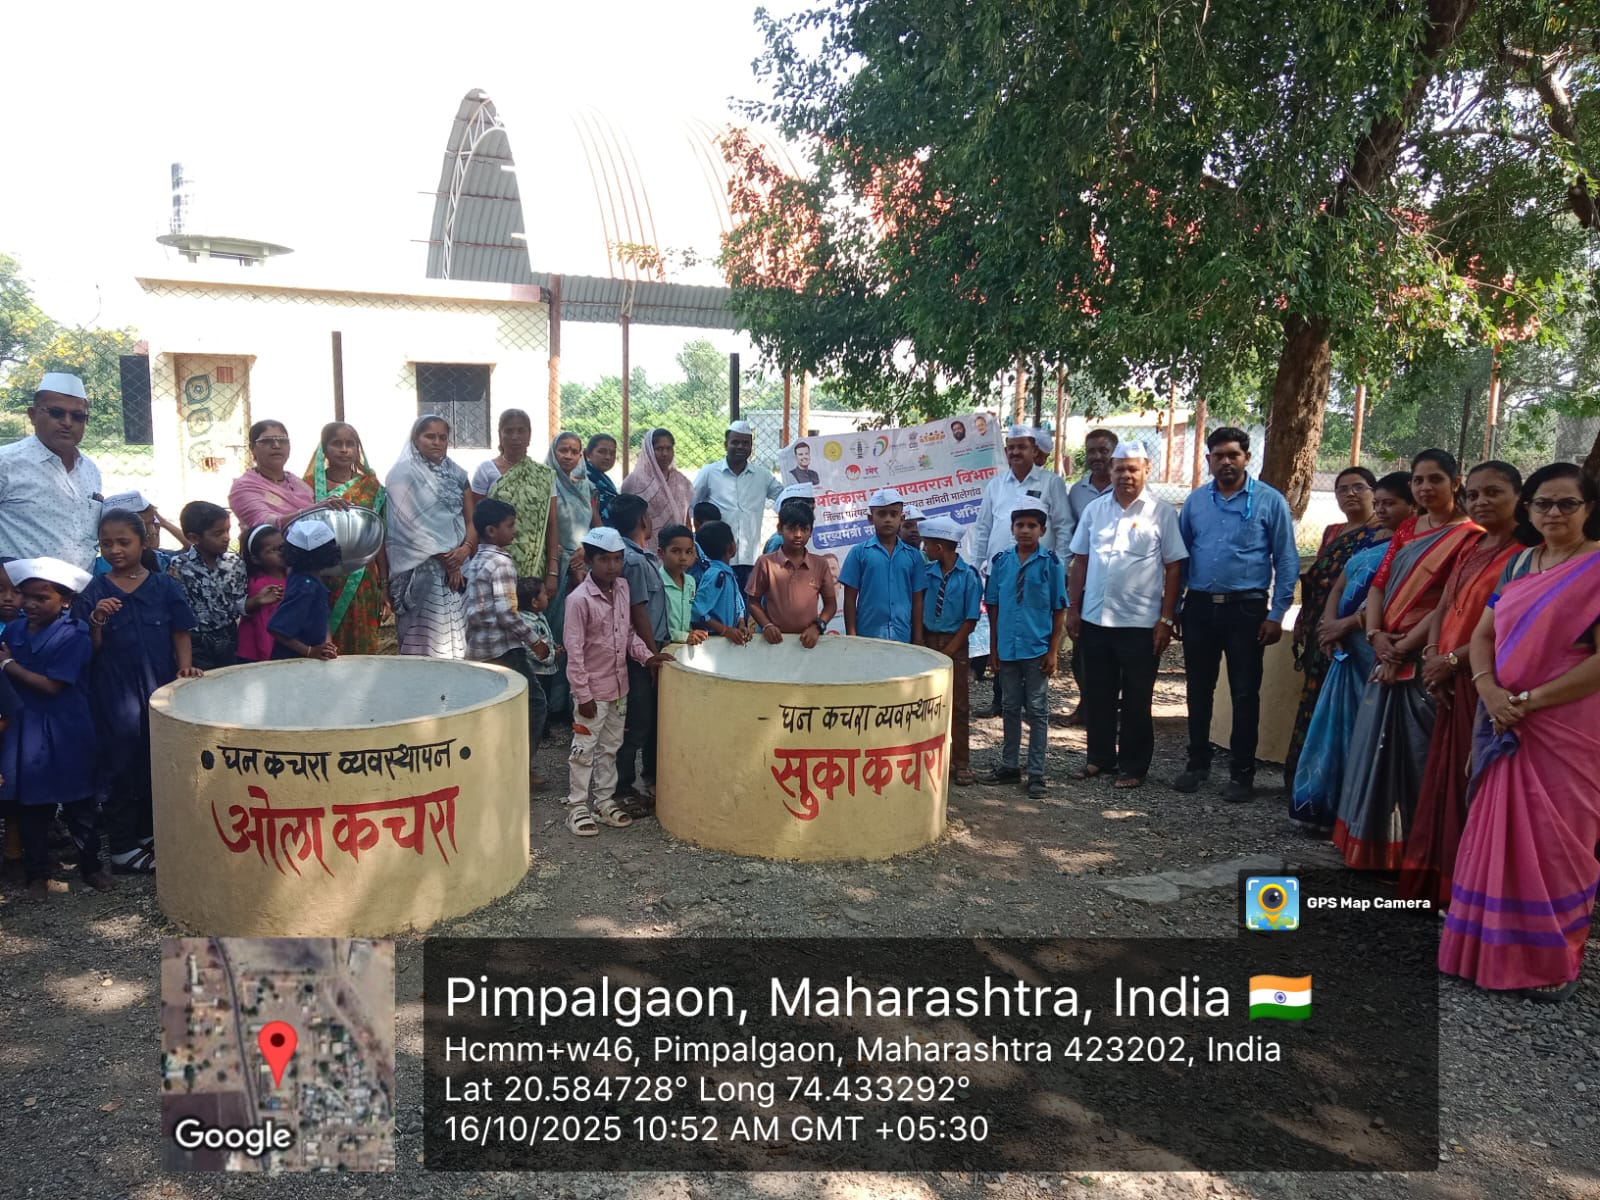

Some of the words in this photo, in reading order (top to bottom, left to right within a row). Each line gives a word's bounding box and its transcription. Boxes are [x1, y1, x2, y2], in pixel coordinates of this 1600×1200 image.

[926, 492, 950, 506] समिती
[817, 524, 862, 547] मुख्यमंत्री
[778, 704, 821, 733] घन
[822, 705, 877, 736] कचरा
[876, 694, 943, 732] व्यवस्थापन
[216, 745, 263, 775] घन
[263, 750, 332, 782] कचरा
[337, 738, 458, 780] व्यवस्थापन
[771, 748, 861, 821] सुका
[862, 733, 946, 795] कचरा
[211, 785, 335, 878] ओला
[331, 785, 460, 865] कचरा
